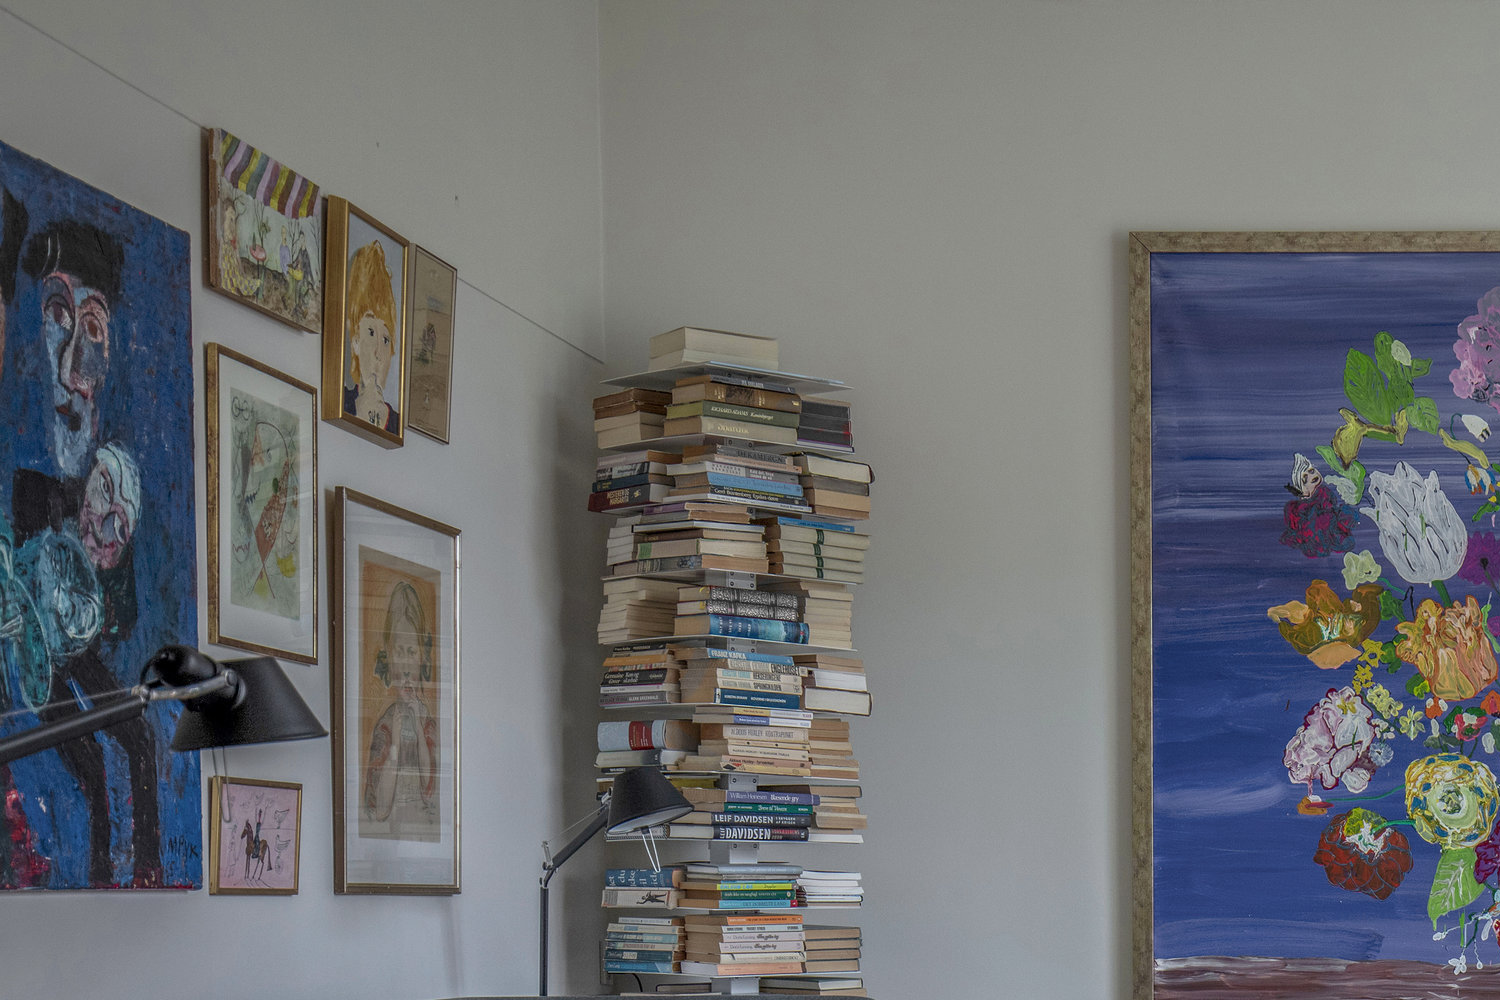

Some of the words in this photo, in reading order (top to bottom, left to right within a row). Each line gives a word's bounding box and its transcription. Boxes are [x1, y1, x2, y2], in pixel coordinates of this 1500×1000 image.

[711, 650, 728, 658] FRANZ
[729, 651, 747, 660] KAFKA
[714, 814, 732, 822] LEIF
[733, 814, 773, 824] DAVIDSEN
[726, 828, 771, 840] DAVIDSEN
